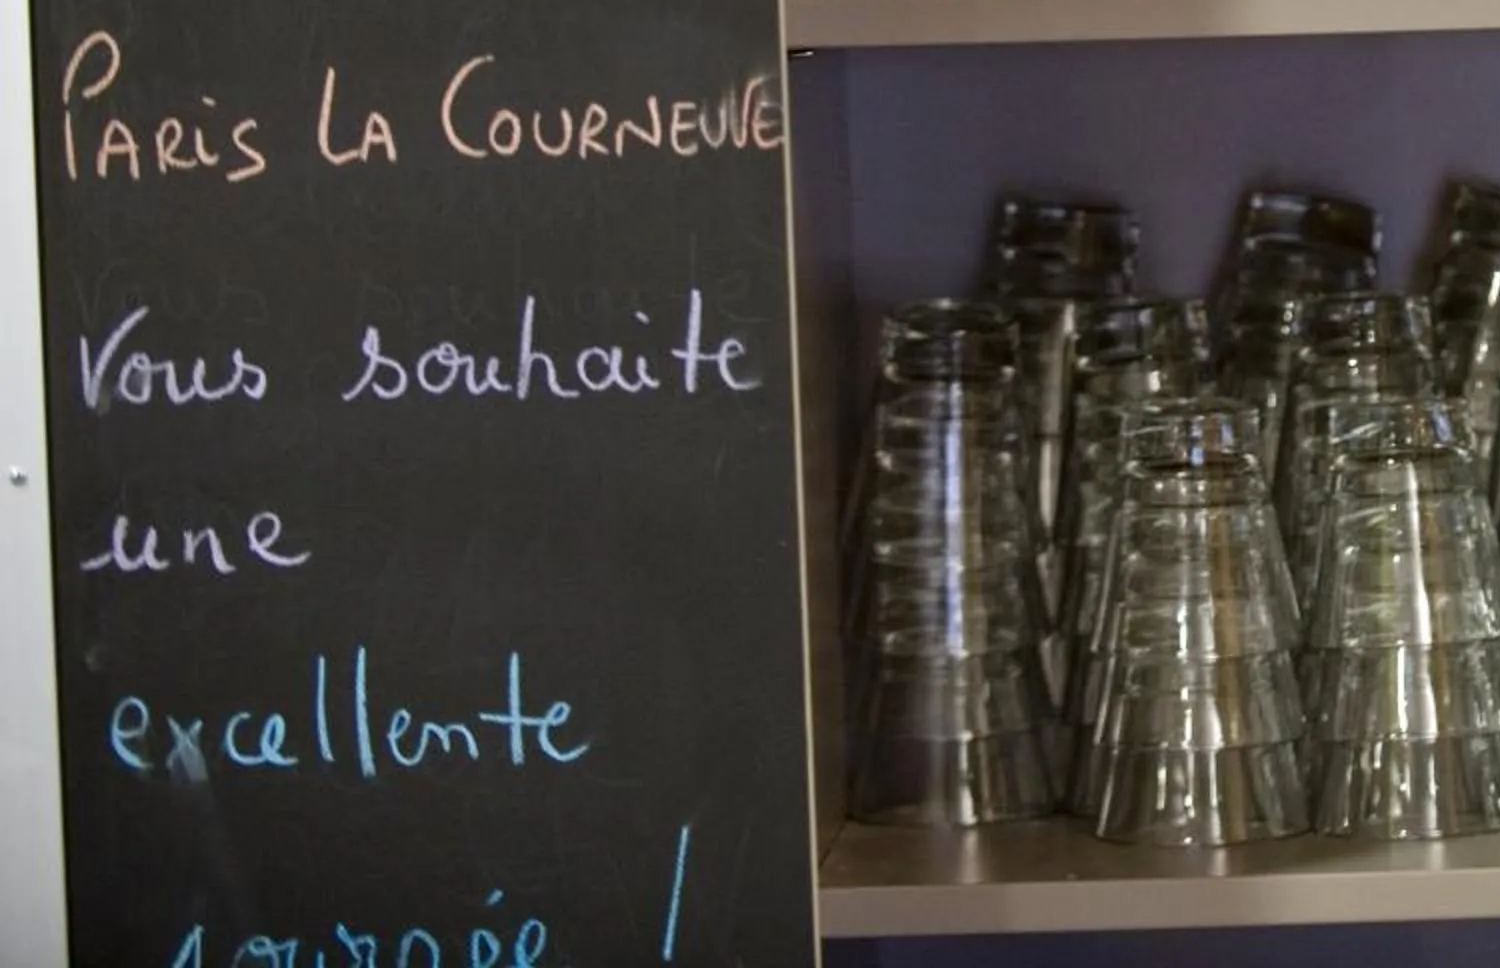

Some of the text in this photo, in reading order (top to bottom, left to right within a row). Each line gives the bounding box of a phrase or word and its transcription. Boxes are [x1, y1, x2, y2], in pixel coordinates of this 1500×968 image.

[318, 67, 397, 164] LA
[440, 54, 784, 159] COURNEUVE
[80, 288, 762, 409] Vous souhaite
[80, 512, 311, 573] une
[110, 645, 589, 776] excellente
